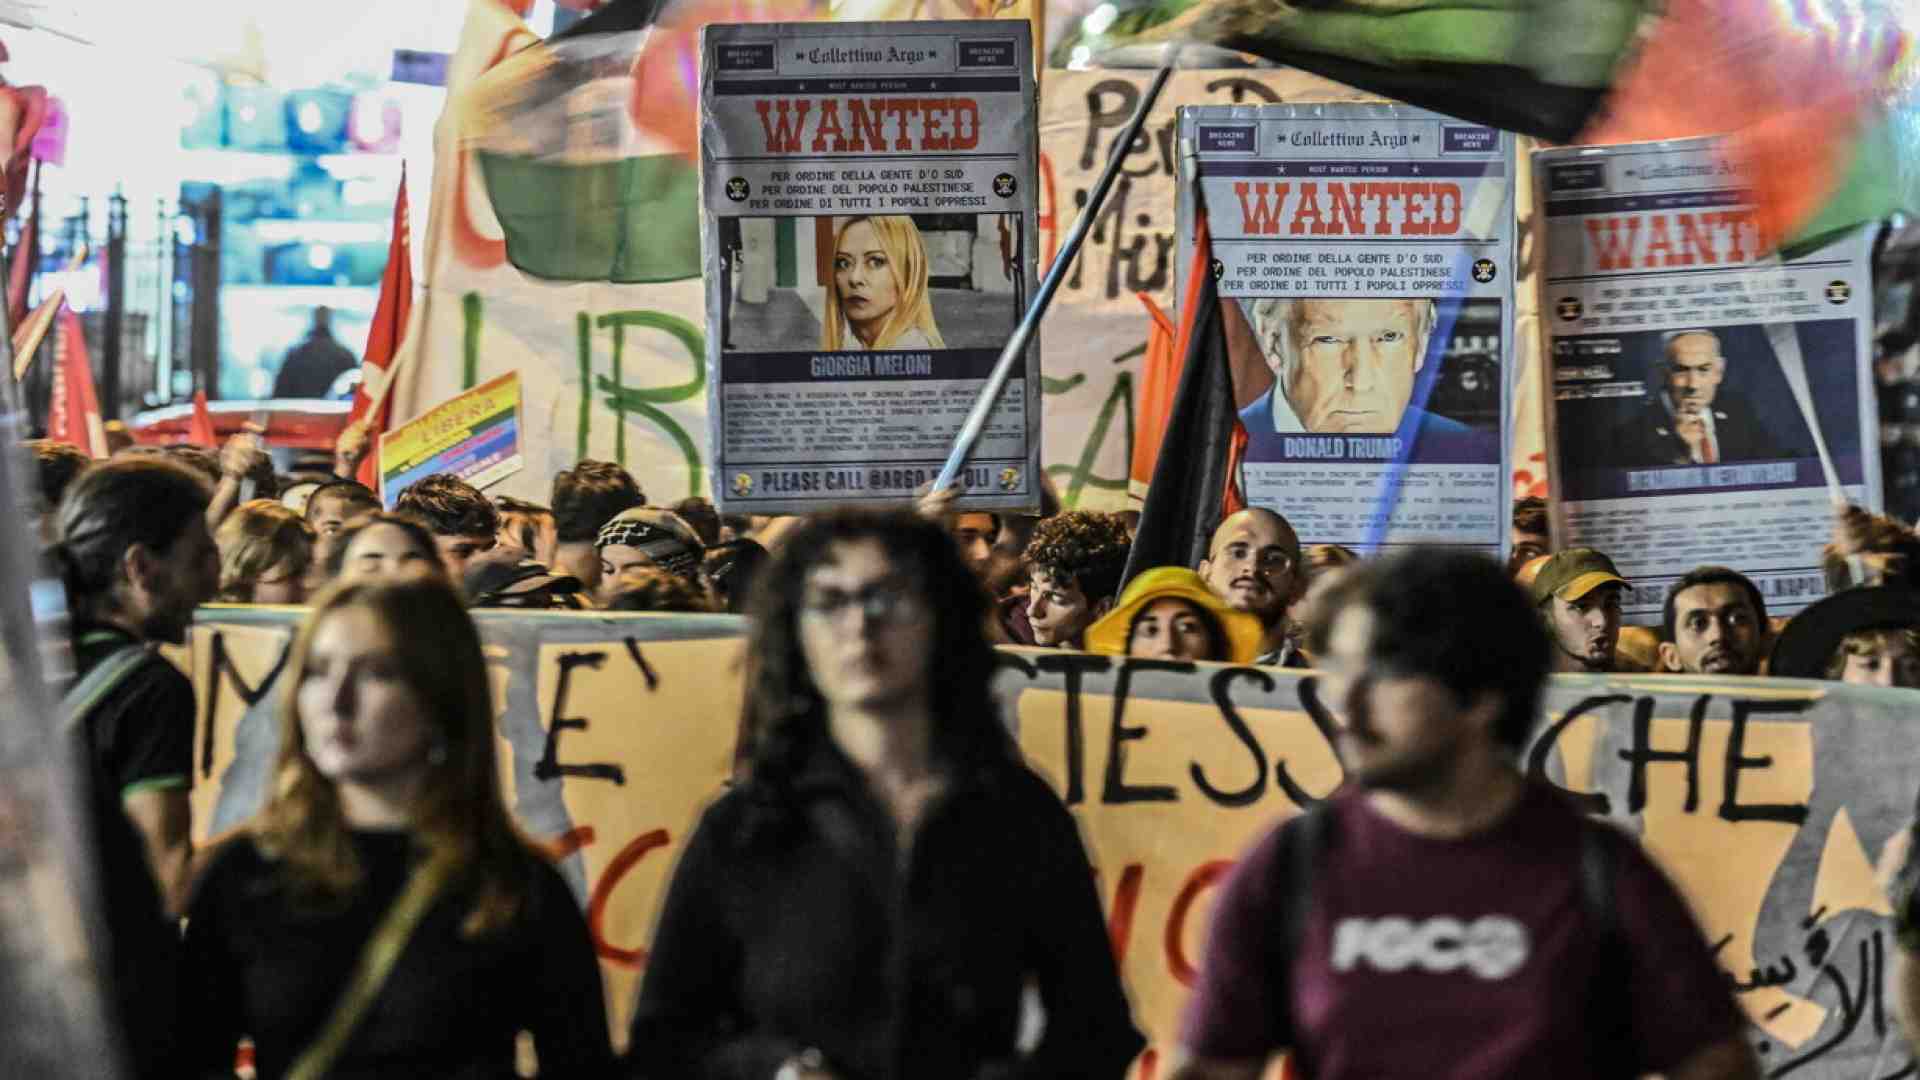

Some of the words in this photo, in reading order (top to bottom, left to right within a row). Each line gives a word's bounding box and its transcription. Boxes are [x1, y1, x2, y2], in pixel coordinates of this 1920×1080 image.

[808, 47, 882, 64] Collettivo
[886, 46, 925, 64] Argo
[755, 98, 979, 152] WANTED
[1291, 131, 1365, 147] Collettivo
[1369, 130, 1407, 149] Argo
[771, 171, 790, 182] PER
[796, 171, 836, 181] ORDINE
[841, 171, 875, 181] DELLA
[880, 170, 913, 180] GENTE
[943, 170, 964, 179] SUD
[761, 185, 781, 196] PER
[786, 185, 825, 195] ORDINE
[832, 185, 852, 194] DEL
[858, 184, 897, 194] POPOLO
[903, 183, 974, 193] PALESTINESE
[750, 199, 770, 209] PER
[774, 199, 813, 209] ORDINE
[819, 199, 832, 208] DI
[840, 198, 871, 208] TUTTI
[891, 198, 929, 207] POPOLI
[935, 196, 987, 207] OPPRESSI
[1234, 182, 1463, 235] WANTED
[1584, 210, 1769, 271] WANT
[1247, 254, 1267, 264] PER
[1272, 254, 1312, 264] ORDINE
[1318, 254, 1351, 264] DELLA
[1357, 254, 1391, 264] GENTE
[1423, 254, 1443, 263] SUD
[1236, 267, 1257, 277] PER
[1263, 267, 1302, 277] ORDINE
[1308, 267, 1327, 277] DEL
[1335, 267, 1374, 277] POPOLO
[1381, 267, 1451, 277] PALESTINESE
[1224, 280, 1244, 290] PER
[1250, 280, 1289, 290] ORDINE
[1295, 280, 1308, 290] DI
[1316, 280, 1347, 290] TUTTI
[1367, 280, 1406, 290] POPOLI
[811, 355, 871, 377] GIORGIA
[874, 355, 932, 376] MELONI
[1284, 437, 1345, 459] DONALD
[1348, 437, 1402, 458] TRUMP
[762, 471, 821, 492] PLEASE
[825, 471, 862, 491] CALL
[1526, 694, 1818, 825] CHE
